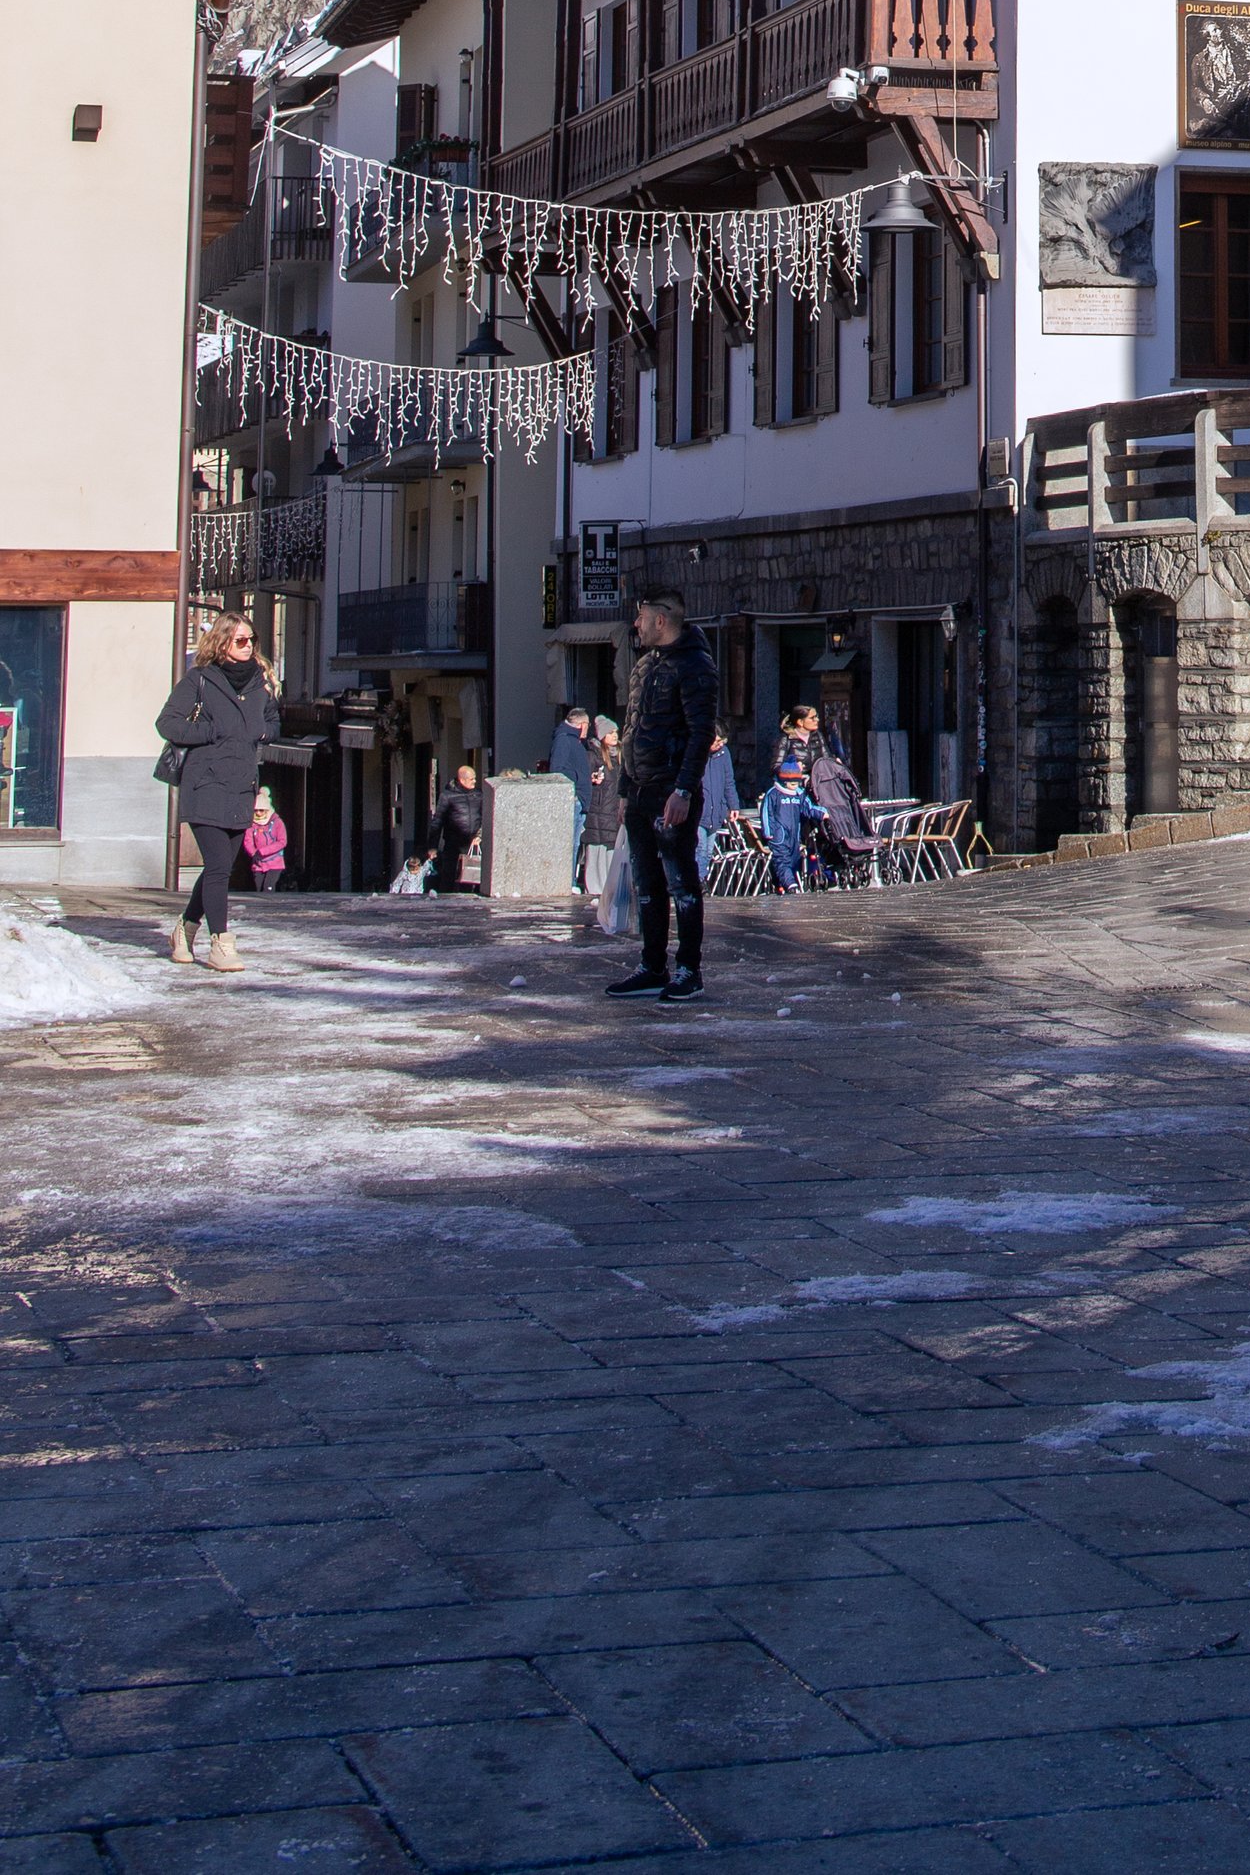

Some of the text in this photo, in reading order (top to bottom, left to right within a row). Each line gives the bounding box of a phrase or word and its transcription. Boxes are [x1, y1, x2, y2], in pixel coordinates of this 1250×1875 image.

[1185, 3, 1212, 14] Duca
[1213, 4, 1239, 17] degli
[1185, 139, 1232, 149] museo alpino
[584, 566, 617, 574] TABACCHI
